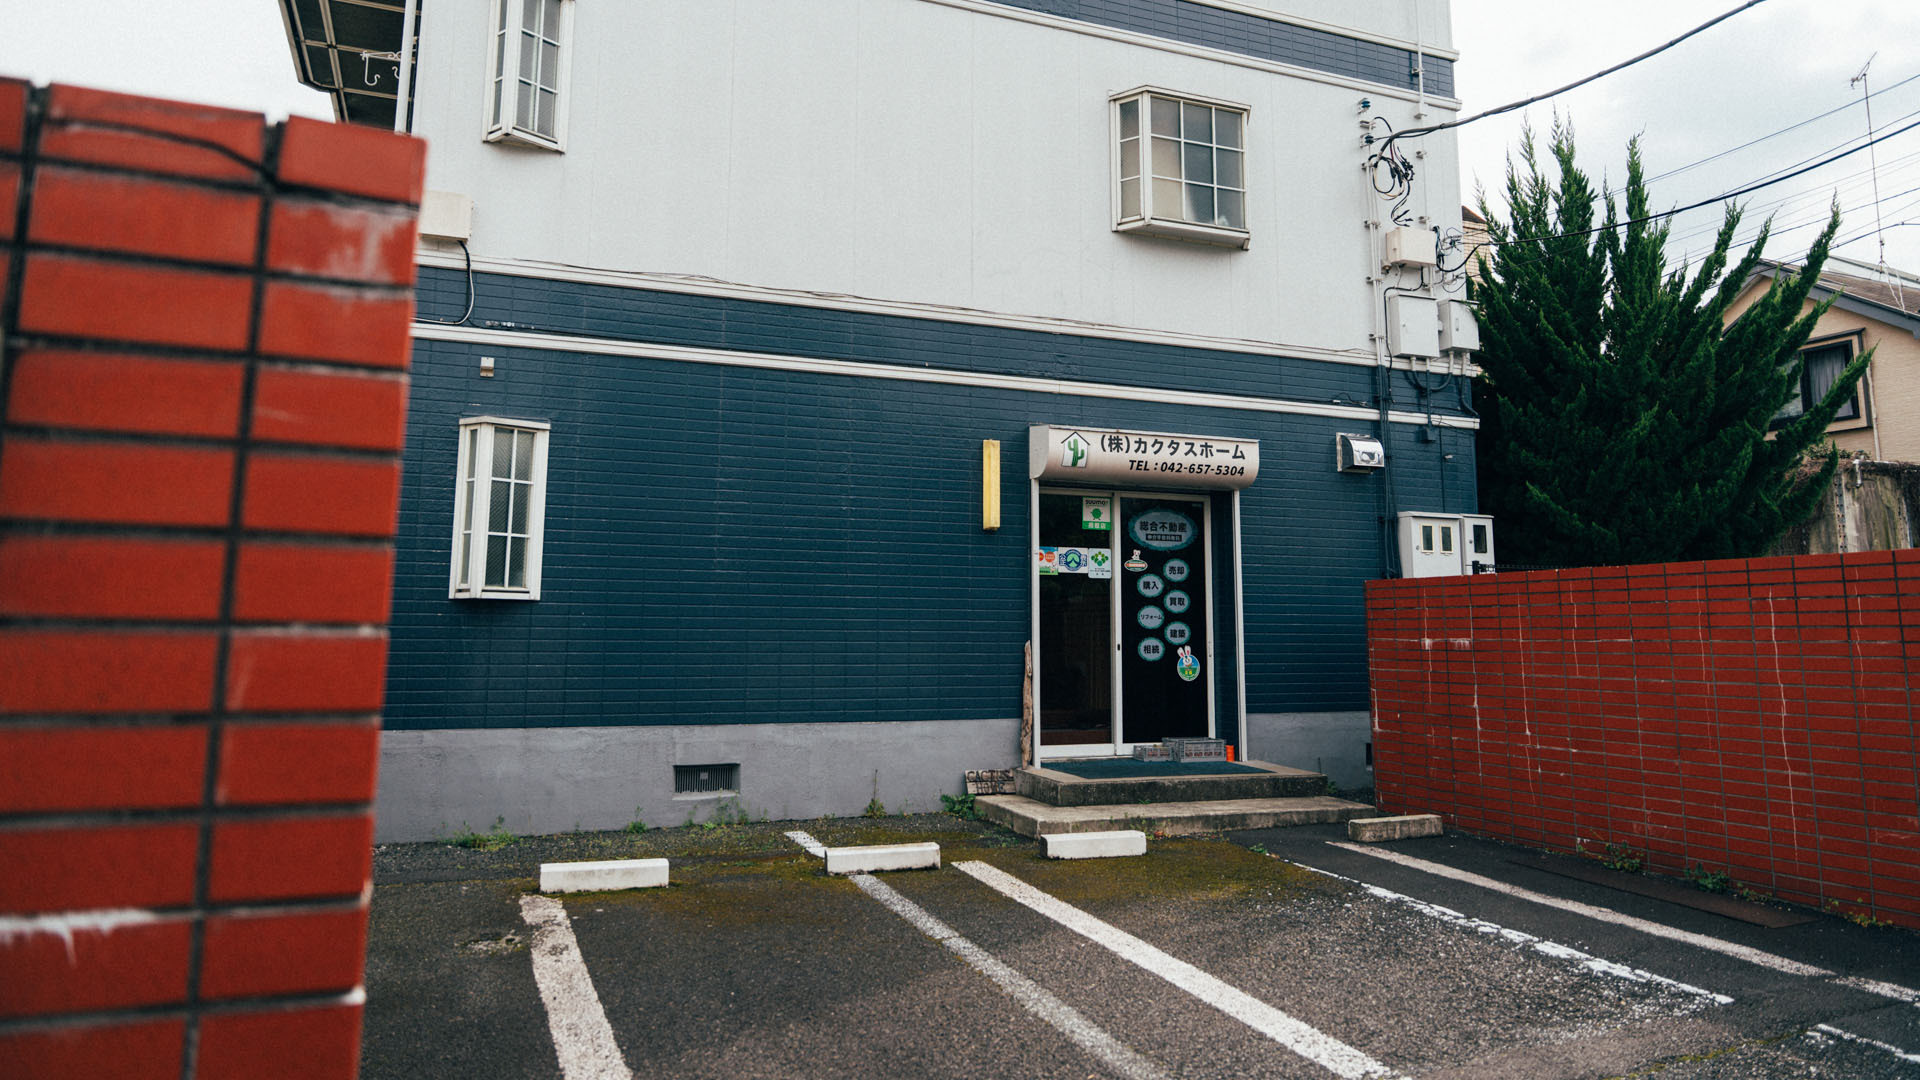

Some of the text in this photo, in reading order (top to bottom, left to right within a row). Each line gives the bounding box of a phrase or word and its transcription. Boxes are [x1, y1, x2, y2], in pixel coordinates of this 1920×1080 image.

[1100, 434, 1246, 460] (株)カクタスホーム
[1139, 521, 1187, 533] 総合不動産
[1168, 566, 1185, 575] 売却
[1143, 581, 1159, 590] 購入
[1169, 597, 1185, 606] 買取
[1170, 629, 1186, 638] 建築
[1143, 645, 1160, 654] 相続
